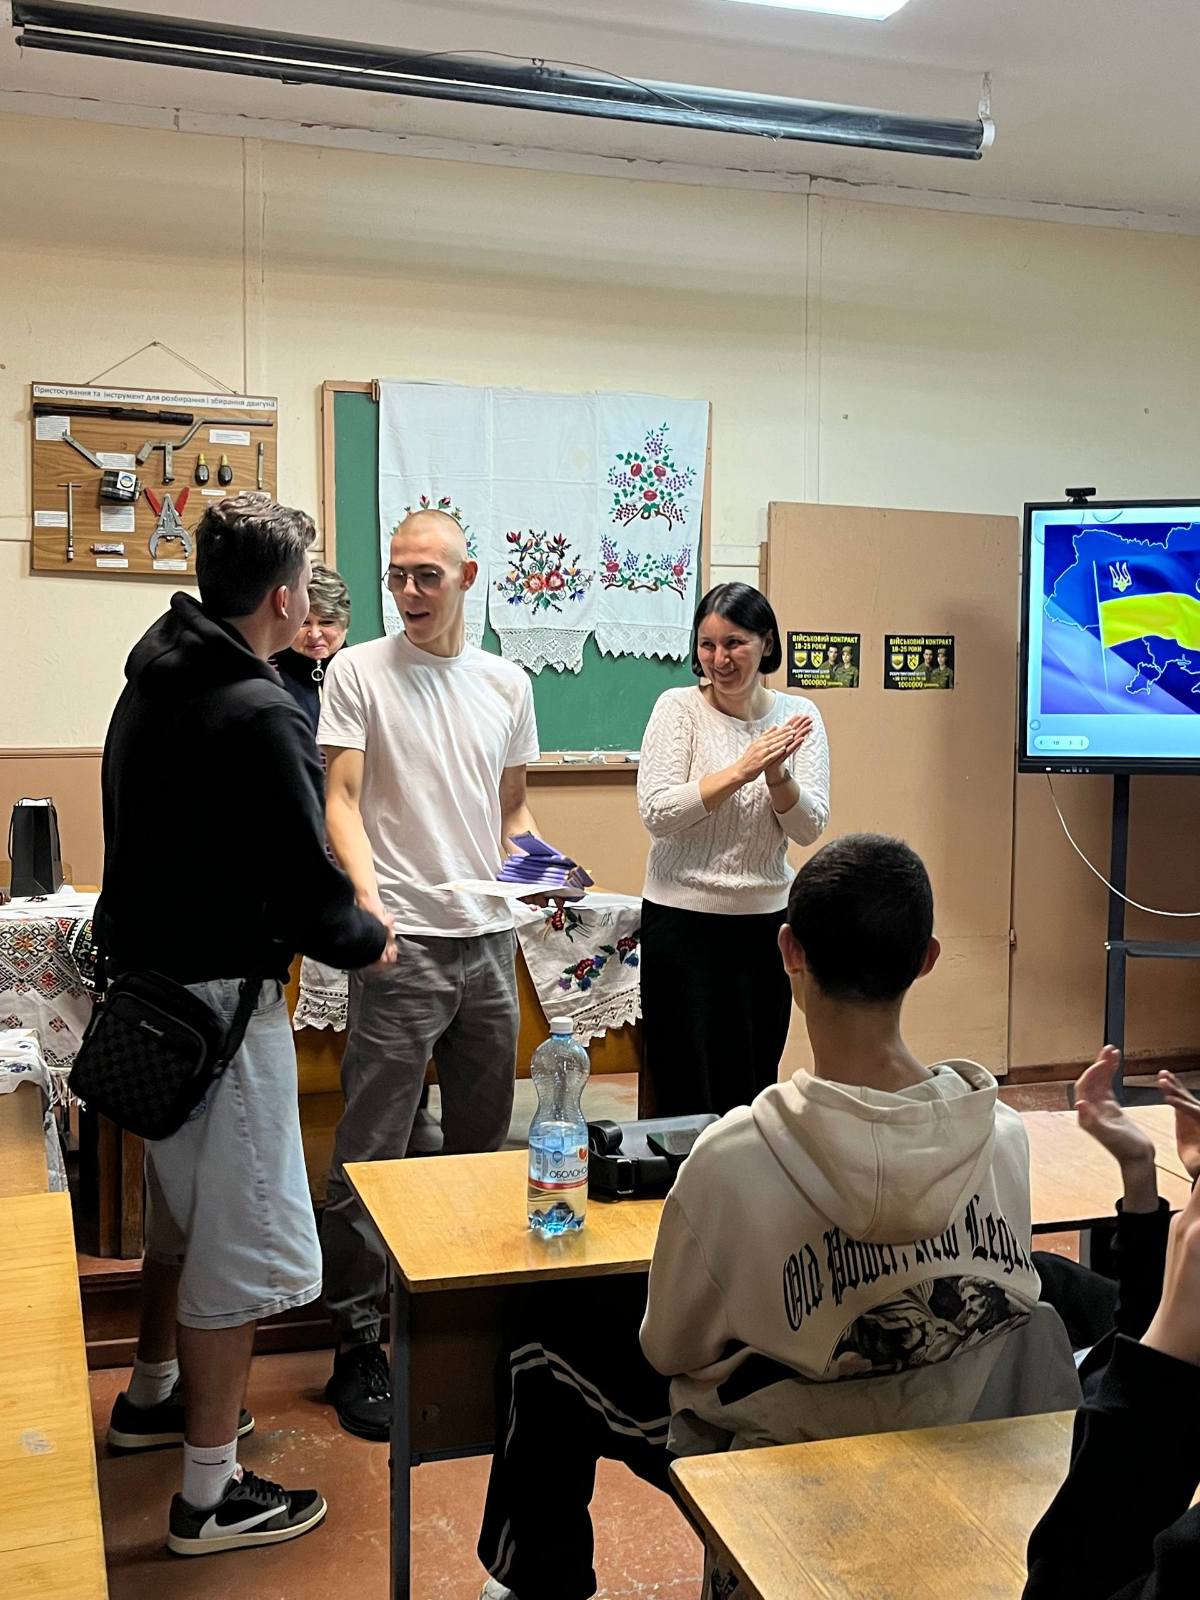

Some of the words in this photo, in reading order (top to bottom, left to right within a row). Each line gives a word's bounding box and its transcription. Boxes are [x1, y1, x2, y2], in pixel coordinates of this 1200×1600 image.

[34, 386, 91, 396] Пристосування
[104, 391, 145, 400] інструмент
[161, 394, 205, 404] розбирання
[210, 397, 245, 406] збирання
[246, 400, 275, 408] двигуна
[792, 634, 830, 643] ВІЙСЬКОВИЙ
[830, 636, 858, 644] КОНТРАКТ
[889, 636, 925, 645] ВІЙСЬКОВИЙ
[925, 638, 952, 646] КОНТРАКТ
[782, 1243, 823, 1332] Old
